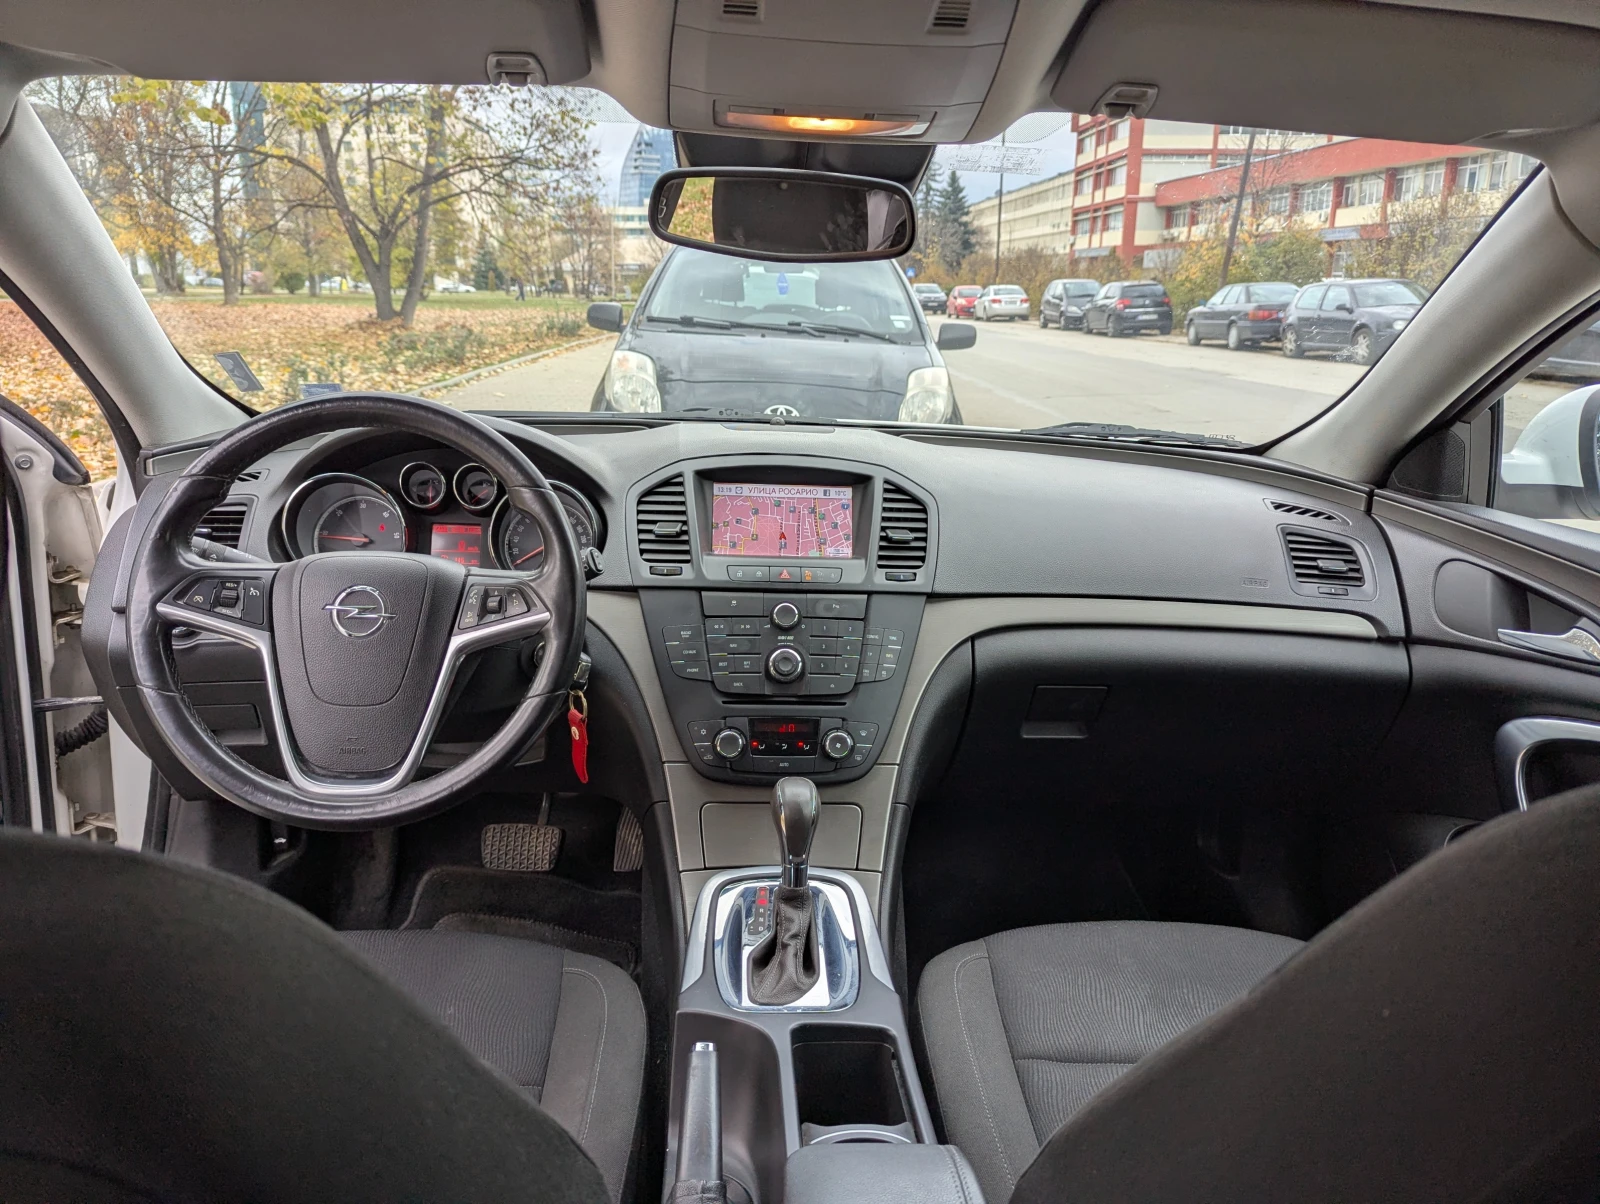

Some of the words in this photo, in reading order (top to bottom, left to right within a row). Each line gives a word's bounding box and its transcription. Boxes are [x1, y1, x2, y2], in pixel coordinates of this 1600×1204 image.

[748, 486, 776, 495] УЛИЦА
[779, 488, 818, 496] РОСАРИО
[338, 746, 367, 755] AIRBAG
